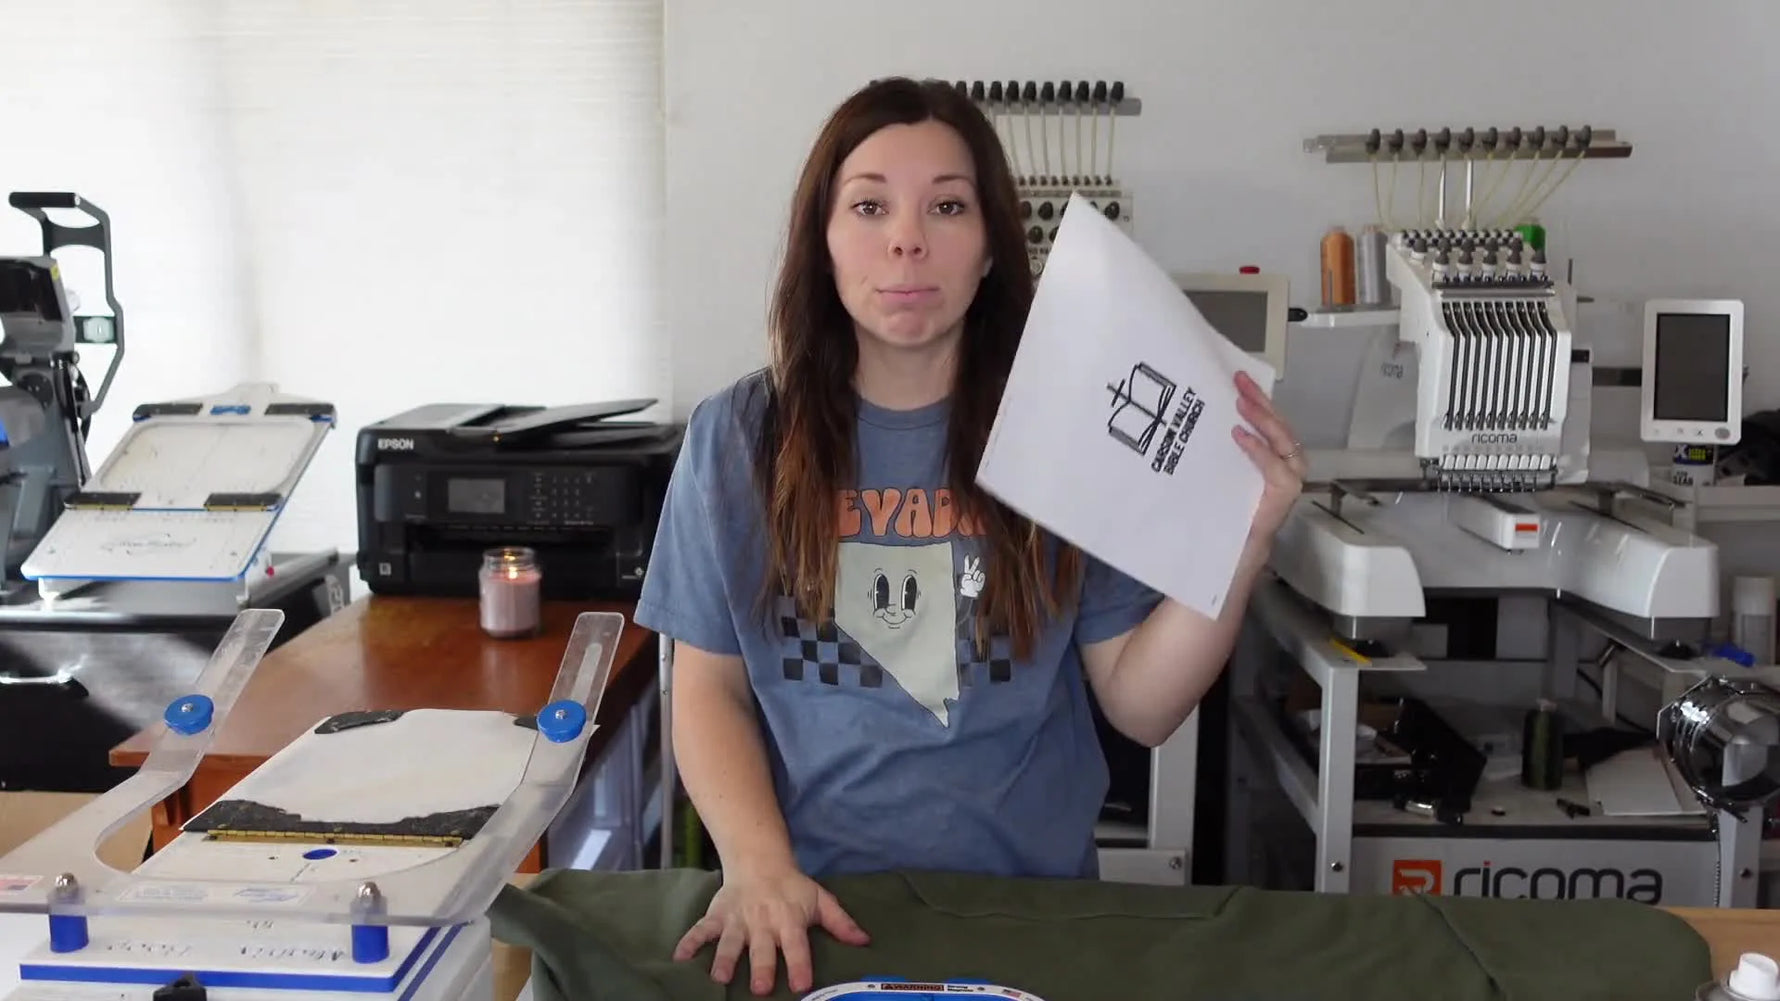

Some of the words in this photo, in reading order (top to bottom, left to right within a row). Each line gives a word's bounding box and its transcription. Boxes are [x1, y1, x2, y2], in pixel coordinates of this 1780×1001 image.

[378, 438, 415, 450] EPSON
[1151, 427, 1178, 473] CARSON
[1170, 386, 1197, 429] VALLEY
[1163, 441, 1185, 475] BIBLE
[1178, 399, 1206, 443] CHURCH
[1471, 432, 1518, 444] ricoma
[838, 487, 988, 539] EVAD
[1454, 861, 1663, 905] ricoma
